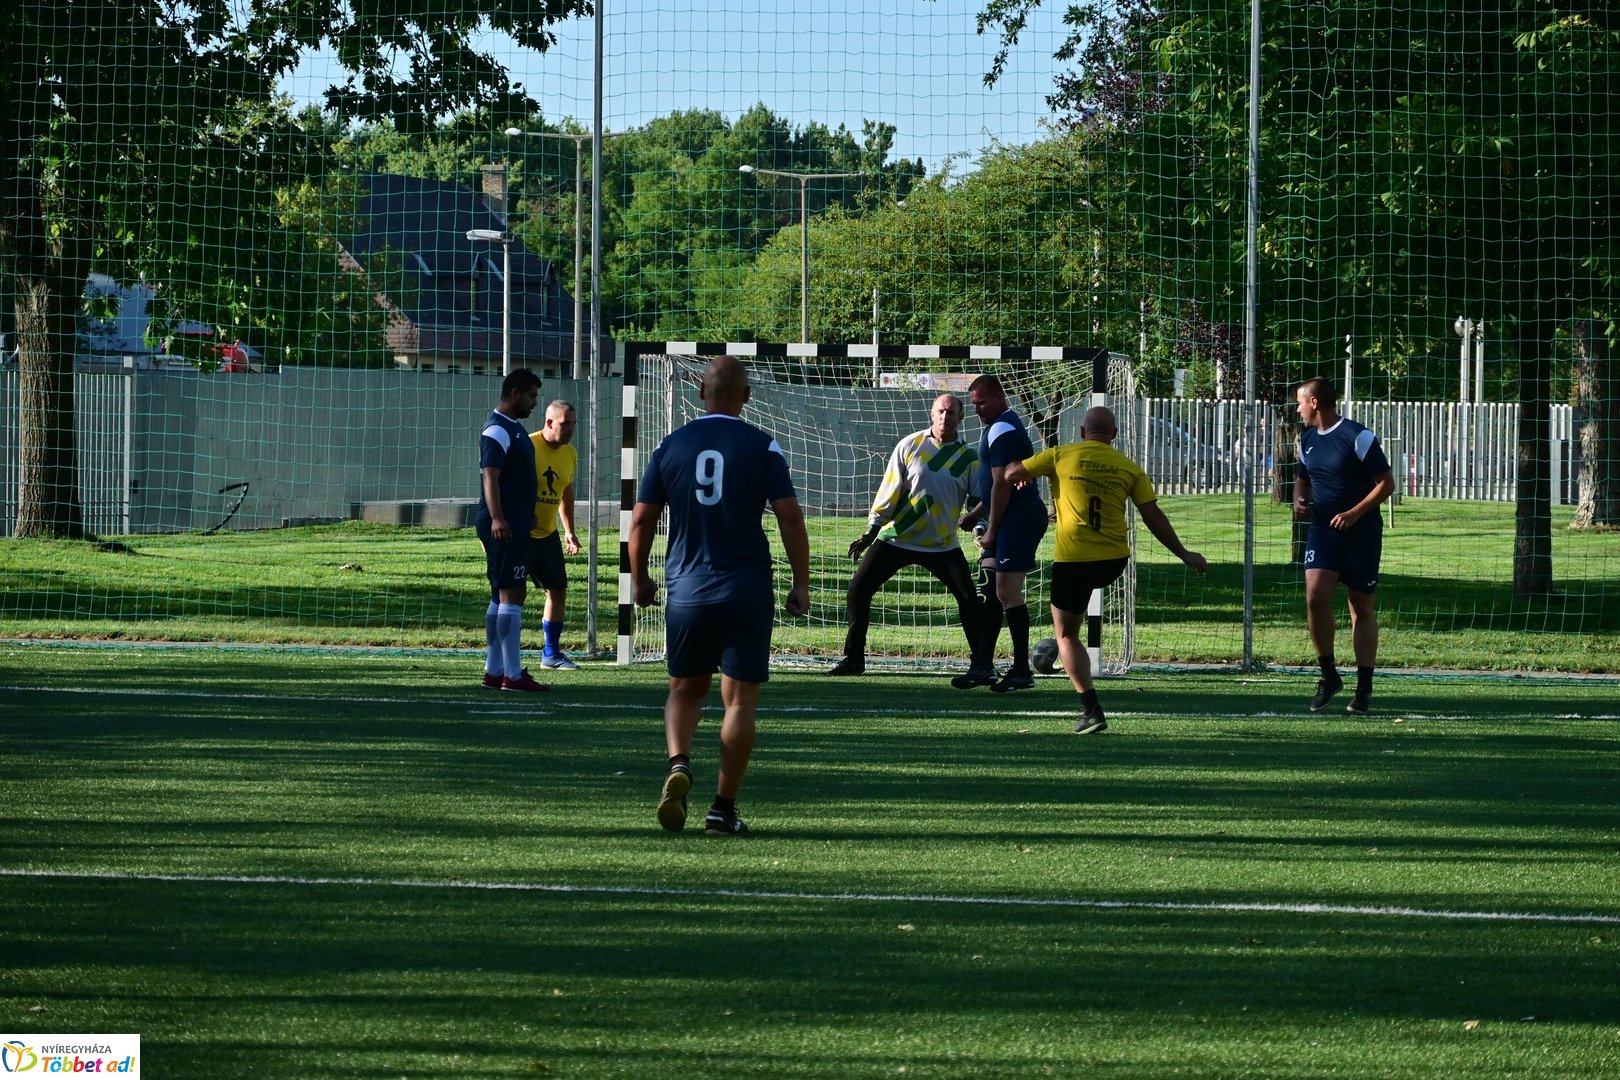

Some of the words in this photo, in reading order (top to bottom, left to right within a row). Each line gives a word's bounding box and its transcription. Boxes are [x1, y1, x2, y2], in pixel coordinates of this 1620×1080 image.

[695, 449, 724, 506] 9
[1089, 495, 1101, 531] 6
[514, 565, 525, 579] 22
